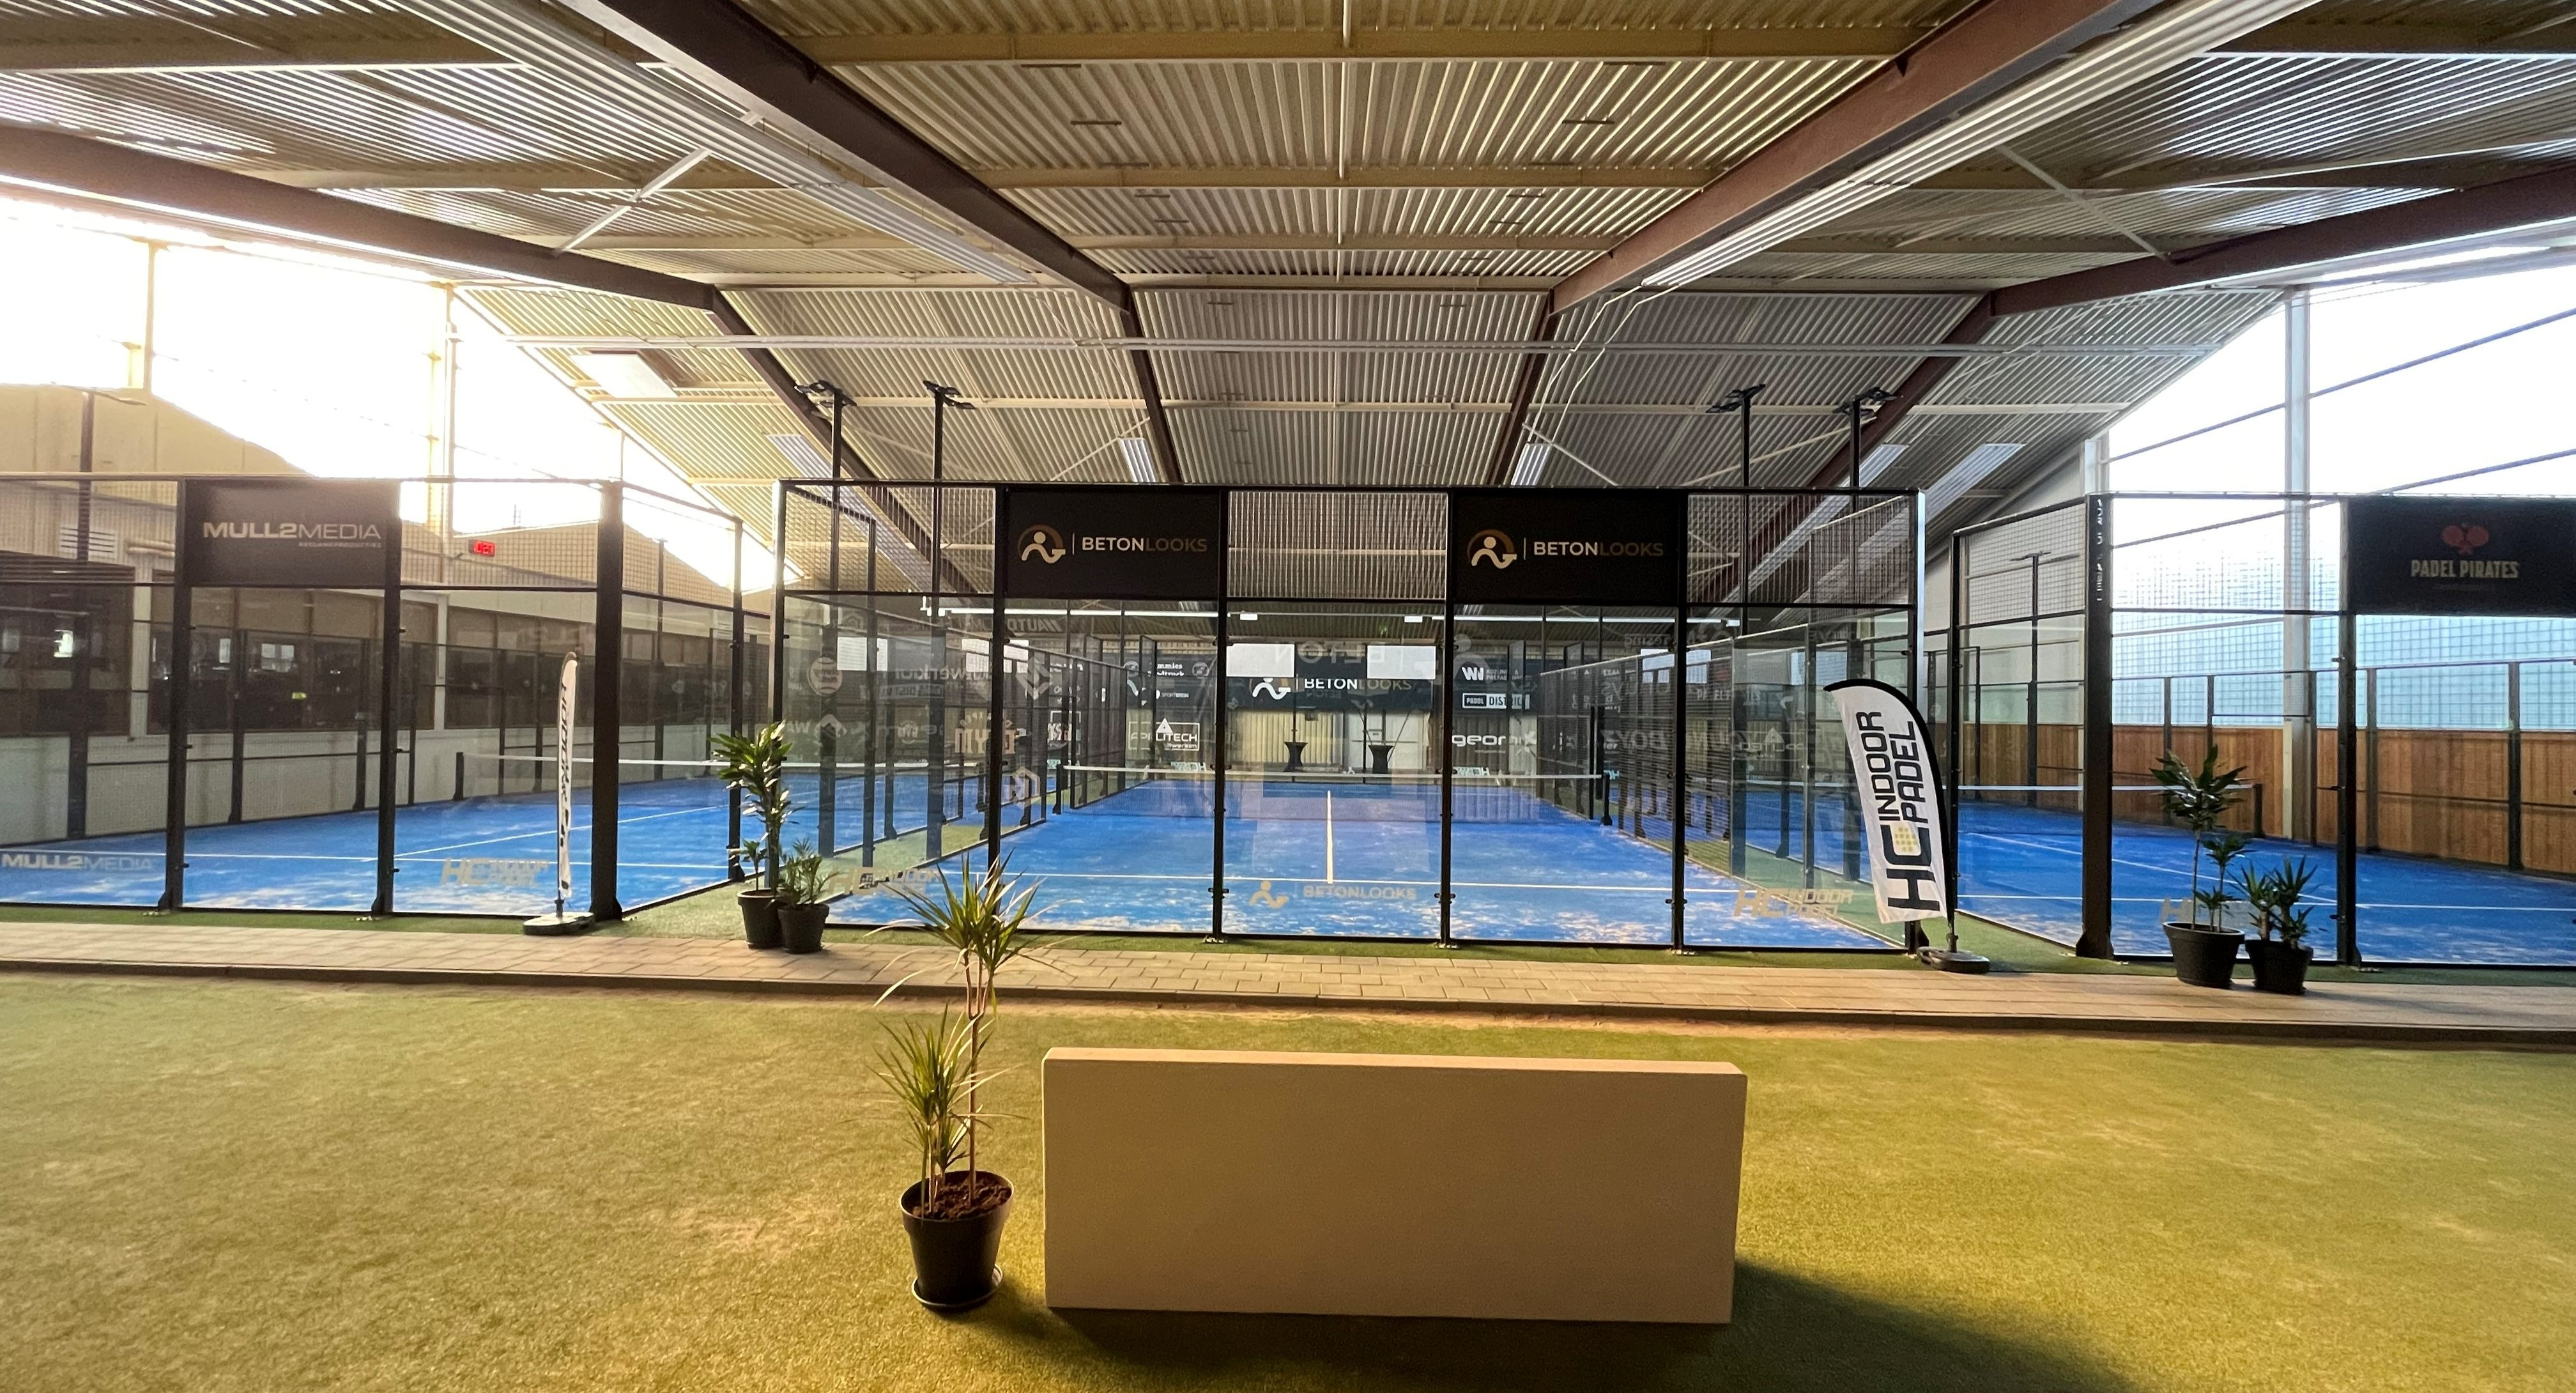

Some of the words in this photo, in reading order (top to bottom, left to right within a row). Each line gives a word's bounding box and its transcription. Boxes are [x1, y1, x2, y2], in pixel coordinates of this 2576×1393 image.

[203, 521, 382, 539] MULL2MEDIA
[1081, 537, 1208, 552] BETONLOOKS
[1533, 541, 1664, 557] BETONLOOKS
[2411, 559, 2456, 577] PADEL
[2460, 560, 2520, 578] PIRATES
[1855, 711, 1901, 822] INDOOR
[1889, 720, 1929, 824] PADEL
[1, 853, 154, 871] MULL2MEDIA
[1880, 824, 1940, 912] HC
[1303, 885, 1416, 900] BETONLOOKS
[1733, 888, 1789, 918] HC
